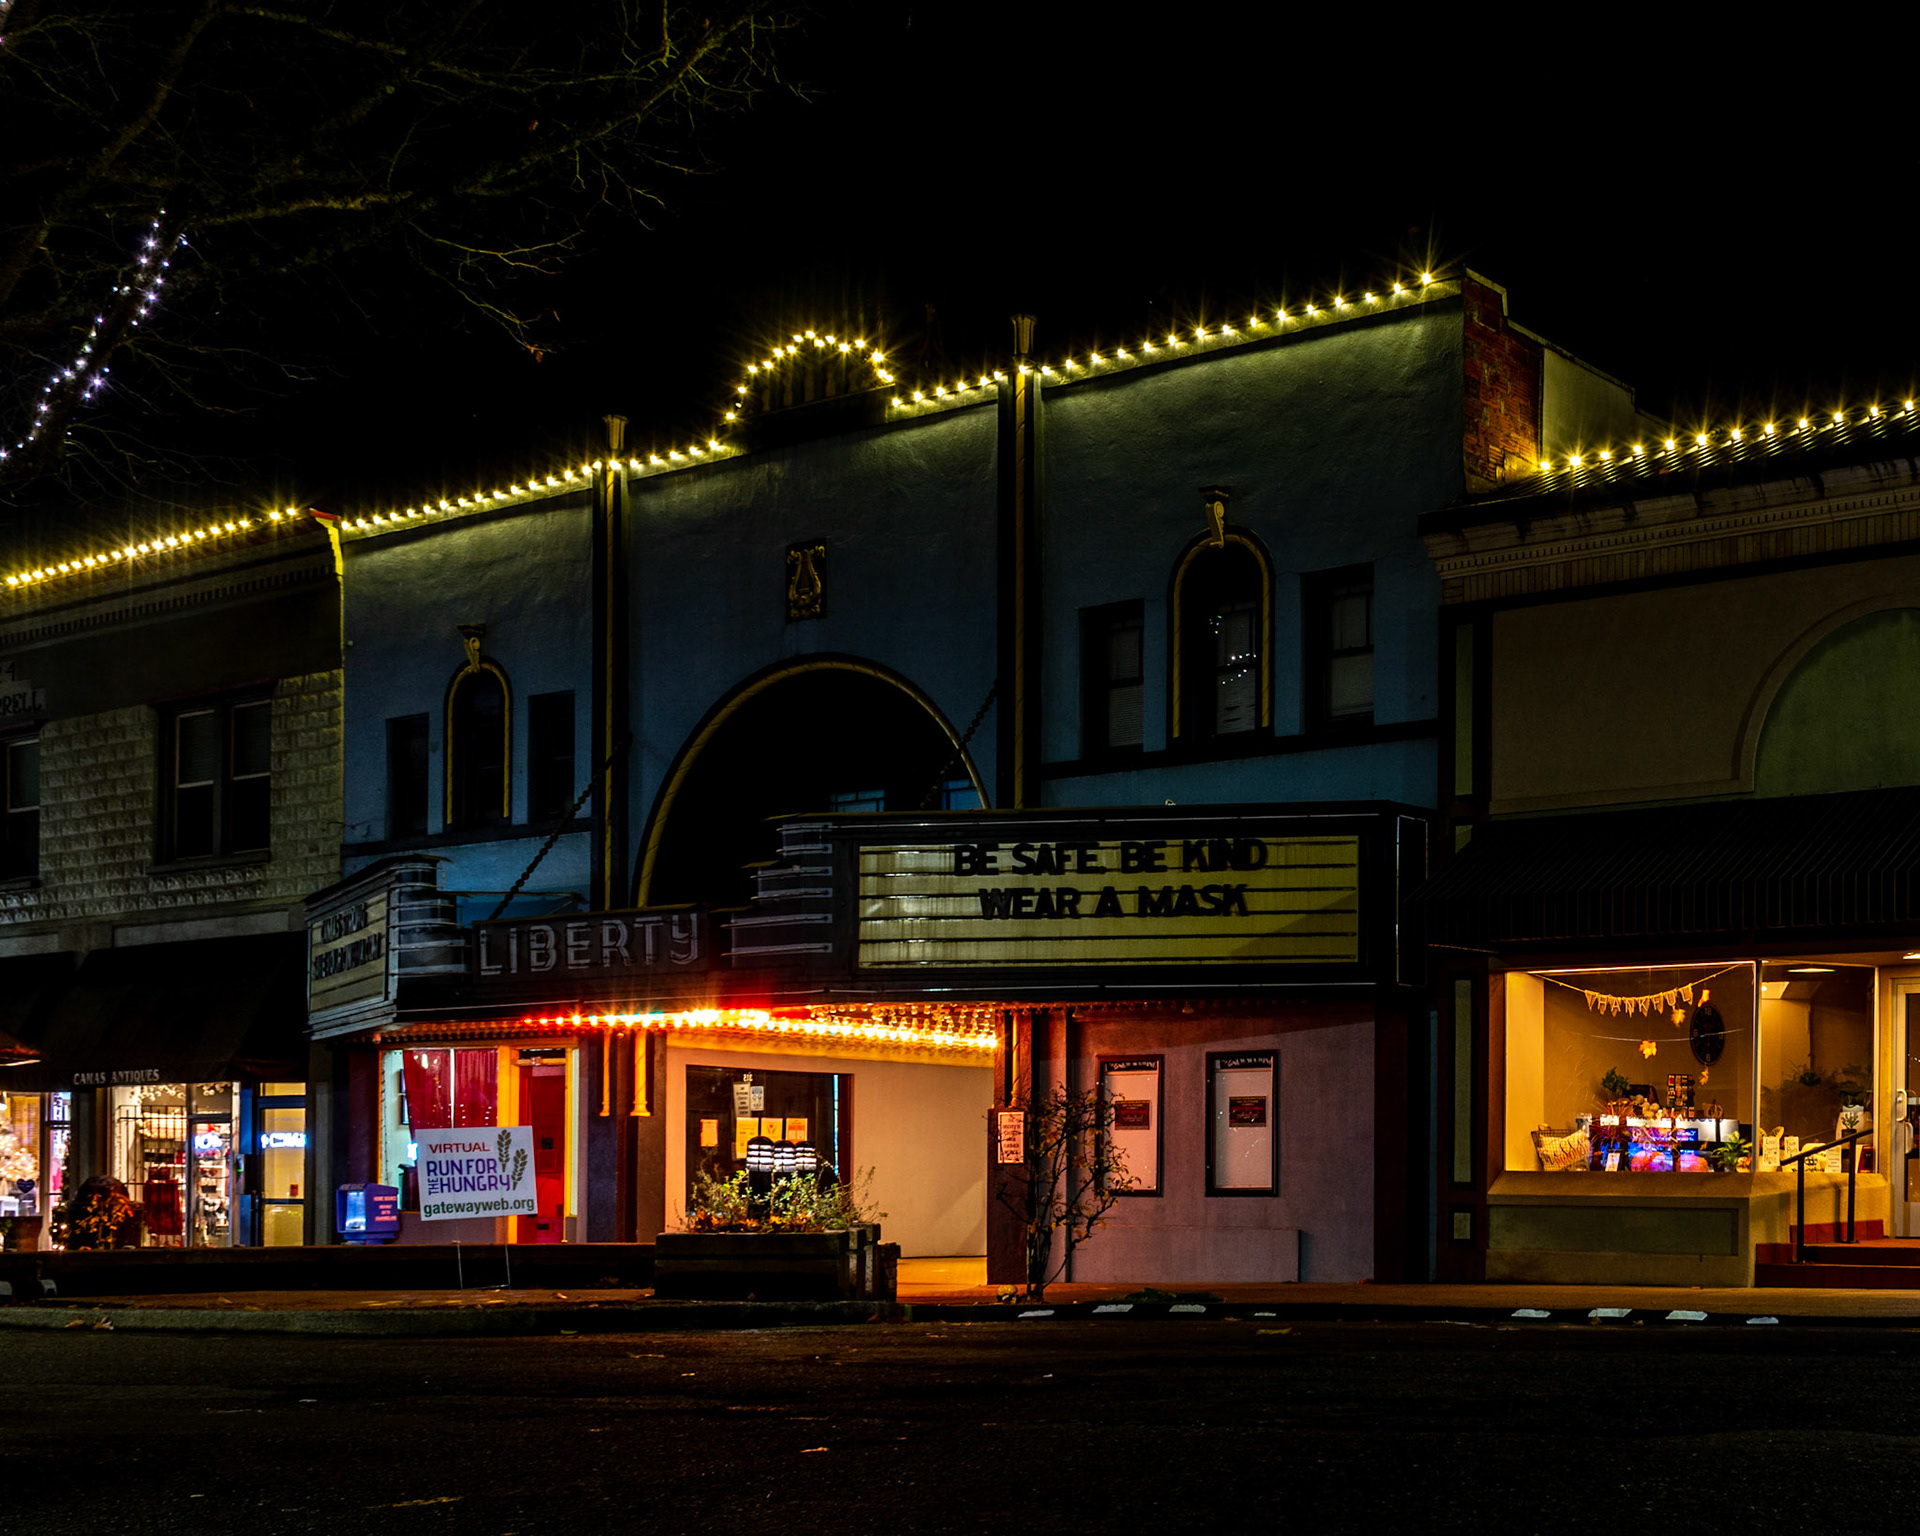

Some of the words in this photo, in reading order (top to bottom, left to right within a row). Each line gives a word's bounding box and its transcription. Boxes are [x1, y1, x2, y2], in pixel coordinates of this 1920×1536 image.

[0, 690, 42, 717] RELL
[955, 844, 999, 876] BE
[1121, 840, 1168, 874] BE
[1183, 838, 1267, 873] KIND
[979, 888, 1081, 920] WEAR
[1094, 887, 1124, 918] A
[1138, 884, 1249, 917] MASK
[479, 912, 699, 976] LIBERTY
[1586, 989, 1691, 1014] THANKFUL
[73, 1072, 106, 1085] CAMAS
[111, 1069, 160, 1083] ANTIQUES
[428, 1142, 491, 1154] VIRTUAL
[426, 1159, 463, 1176] RUN
[466, 1158, 497, 1174] FOR
[427, 1177, 440, 1195] THE
[440, 1174, 511, 1193] HUNGRY
[424, 1198, 535, 1217] gatewayweb.org
